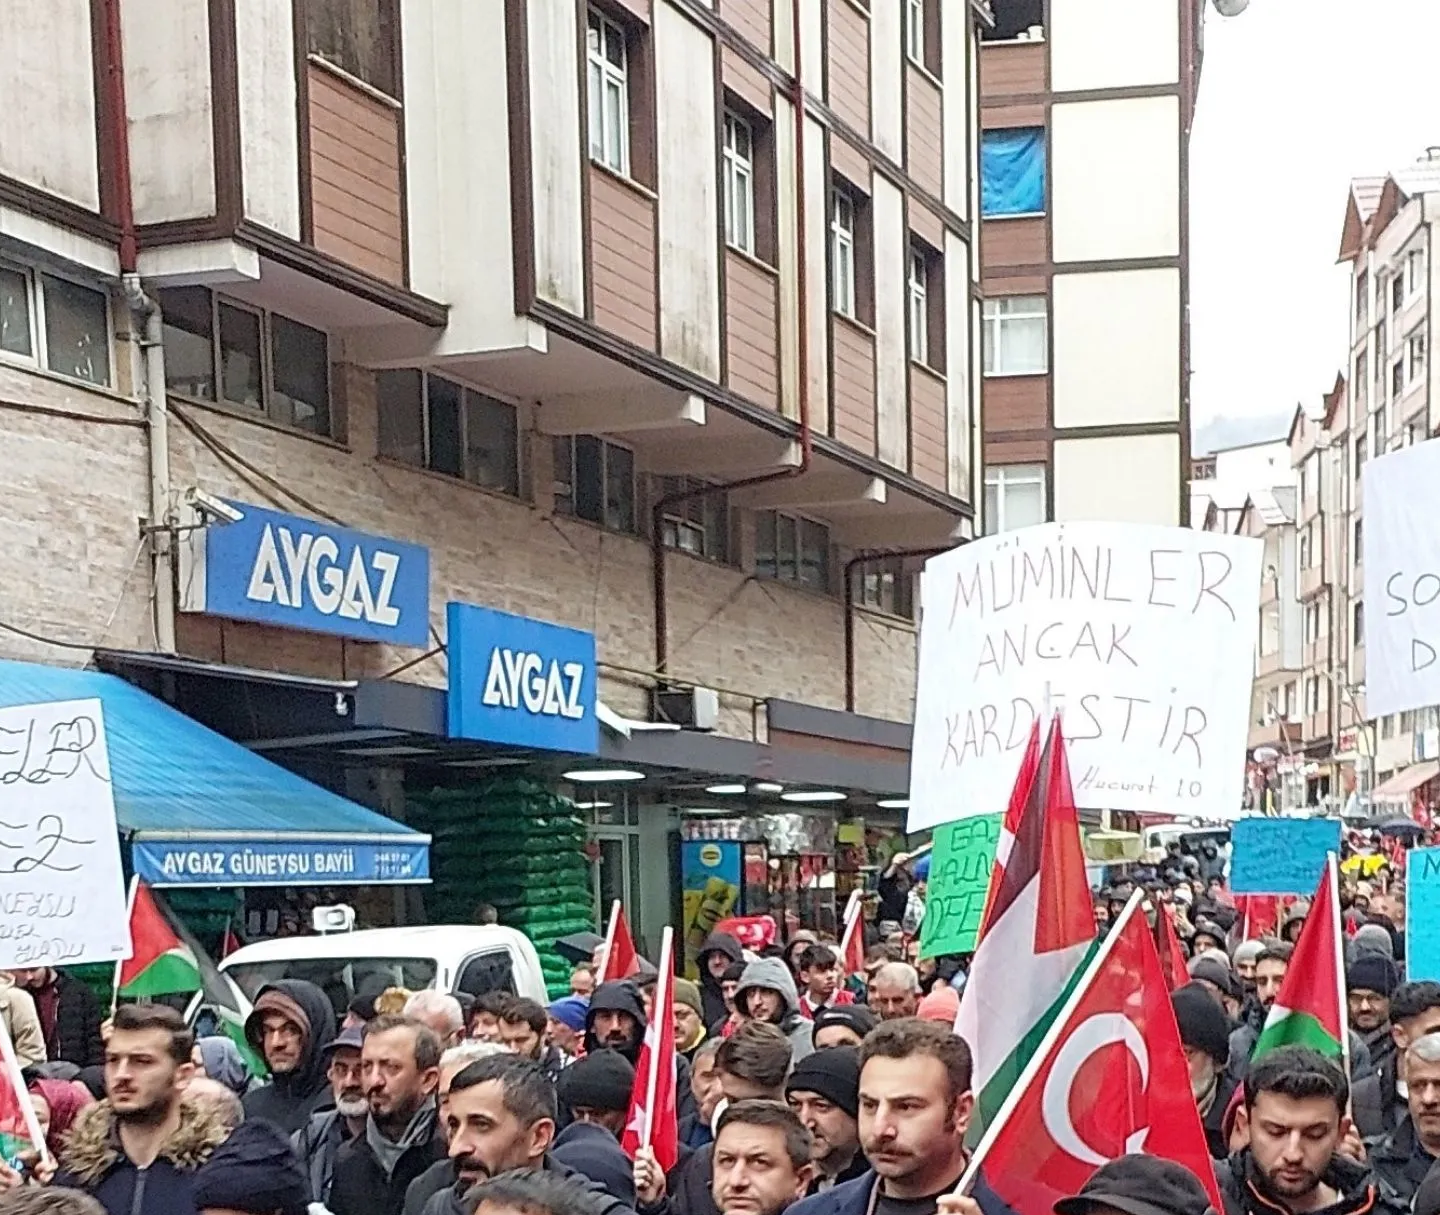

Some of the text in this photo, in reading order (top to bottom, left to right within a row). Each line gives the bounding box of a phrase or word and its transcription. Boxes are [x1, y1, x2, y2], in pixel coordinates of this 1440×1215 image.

[246, 522, 401, 627] AYGAZ
[481, 645, 585, 720] AYGAZ
[973, 621, 1138, 684] ANCAK
[1176, 778, 1204, 798] 10
[163, 851, 225, 875] AYGAZ
[230, 848, 310, 876] GÜNEYSU
